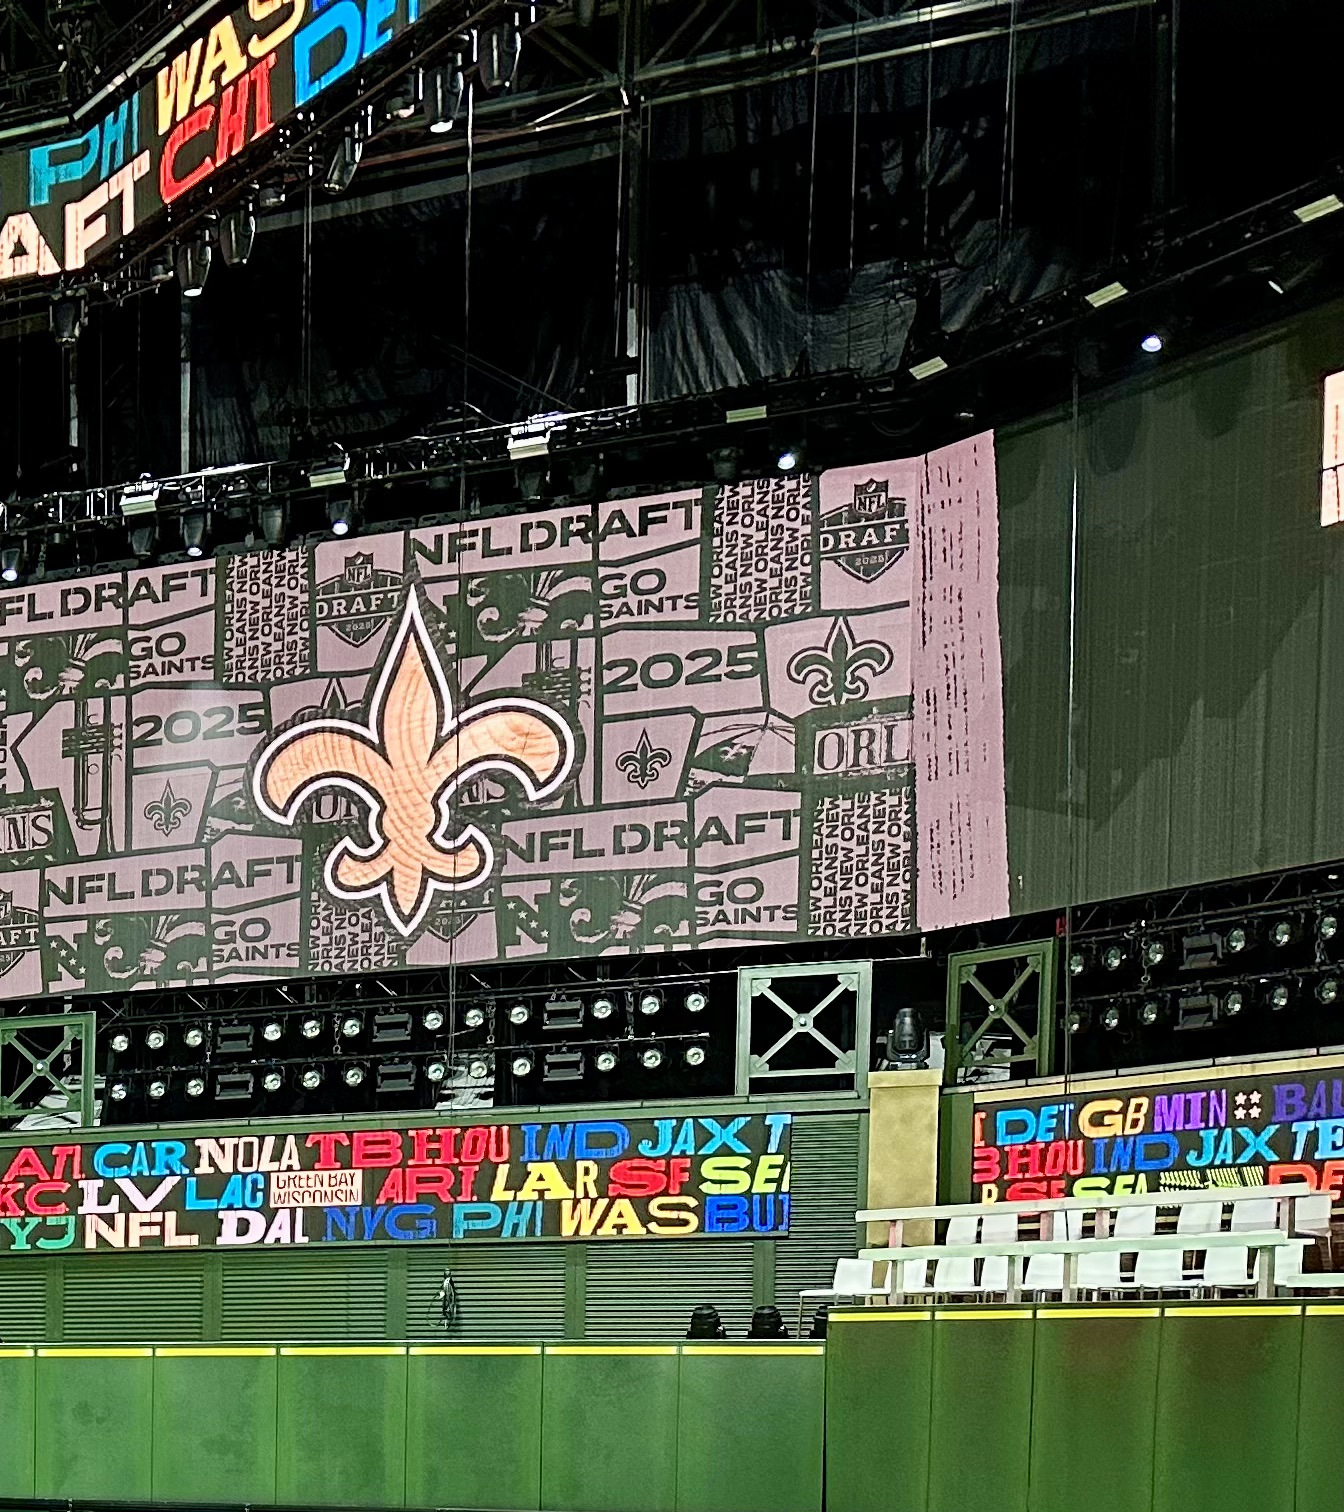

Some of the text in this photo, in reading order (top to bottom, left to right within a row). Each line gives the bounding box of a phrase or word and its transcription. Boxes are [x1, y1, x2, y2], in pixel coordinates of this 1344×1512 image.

[29, 92, 140, 206] PHI
[156, 0, 305, 136] WAS
[160, 52, 279, 204] CHI
[412, 498, 703, 568] NFL DRAFT
[59, 569, 215, 617] DRAFT
[598, 592, 702, 620] SAINTS
[599, 568, 668, 600] GO
[130, 631, 188, 662] GO
[130, 654, 214, 680] SAINTS
[602, 644, 761, 695] 2025
[132, 705, 266, 747] 2025
[818, 724, 910, 771] ORL
[505, 809, 801, 865] NFL DRAFT
[46, 855, 303, 907] NFL DRAFT
[695, 876, 765, 908] GO
[213, 917, 272, 944] GO
[1077, 1089, 1227, 1139] GB MIN
[93, 1140, 190, 1178] CAR
[194, 1135, 302, 1174] NOLA
[407, 1125, 510, 1166] HOU
[520, 1121, 630, 1162] IND
[638, 1116, 752, 1157] JAX
[1003, 1124, 1281, 1181] HOU IND JAX
[77, 1176, 182, 1214] LV
[185, 1172, 264, 1210] LAC
[607, 1158, 692, 1198] SF
[84, 1211, 199, 1249] NFL
[215, 1208, 310, 1245] DAL
[452, 1201, 543, 1239] PHI
